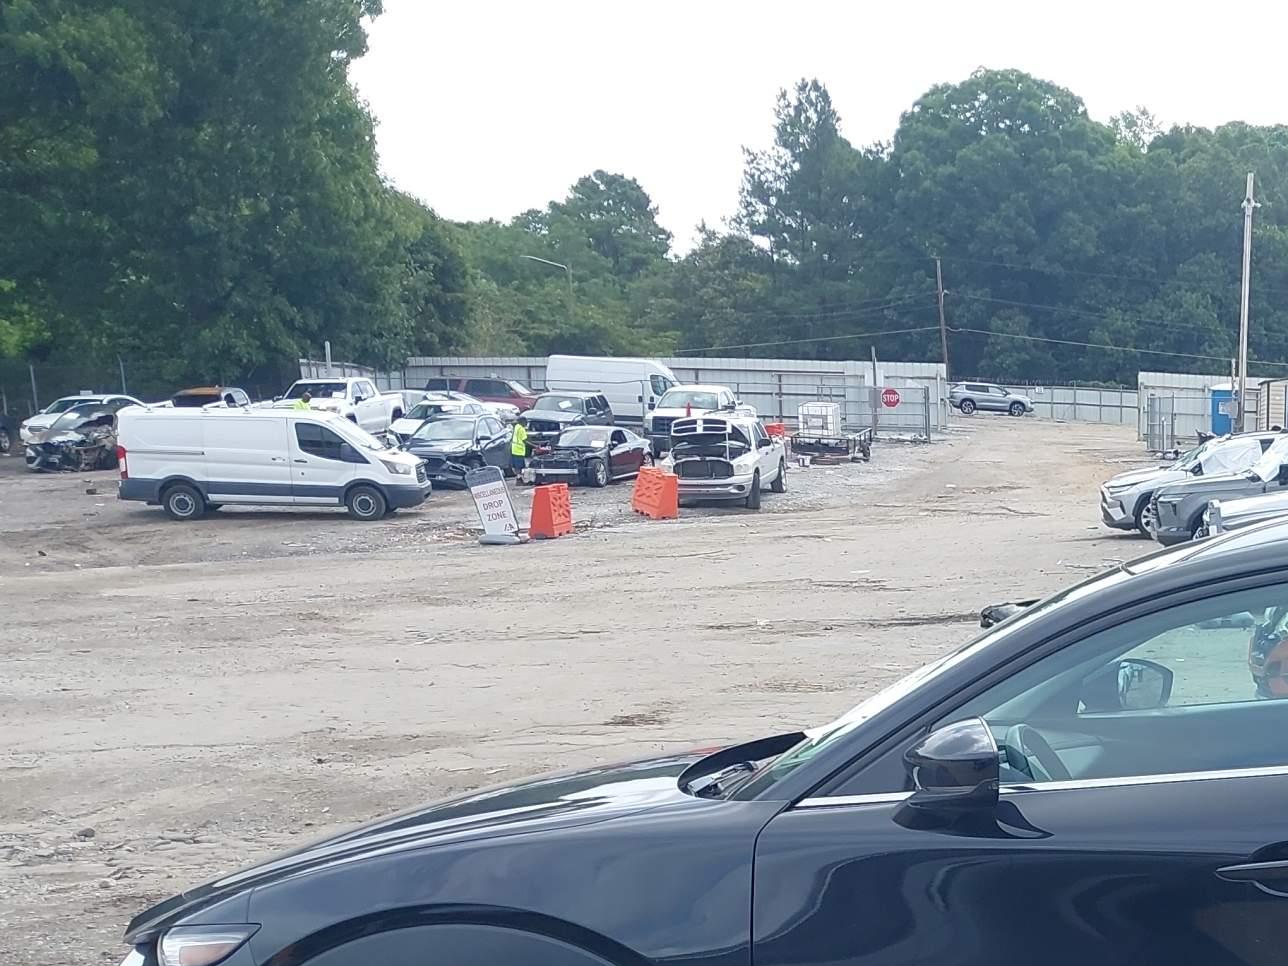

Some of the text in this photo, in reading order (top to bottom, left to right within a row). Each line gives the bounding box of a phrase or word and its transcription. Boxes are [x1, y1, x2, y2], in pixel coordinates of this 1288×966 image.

[882, 394, 899, 403] STOP
[483, 500, 503, 510] DROP
[488, 511, 507, 521] ZONE
